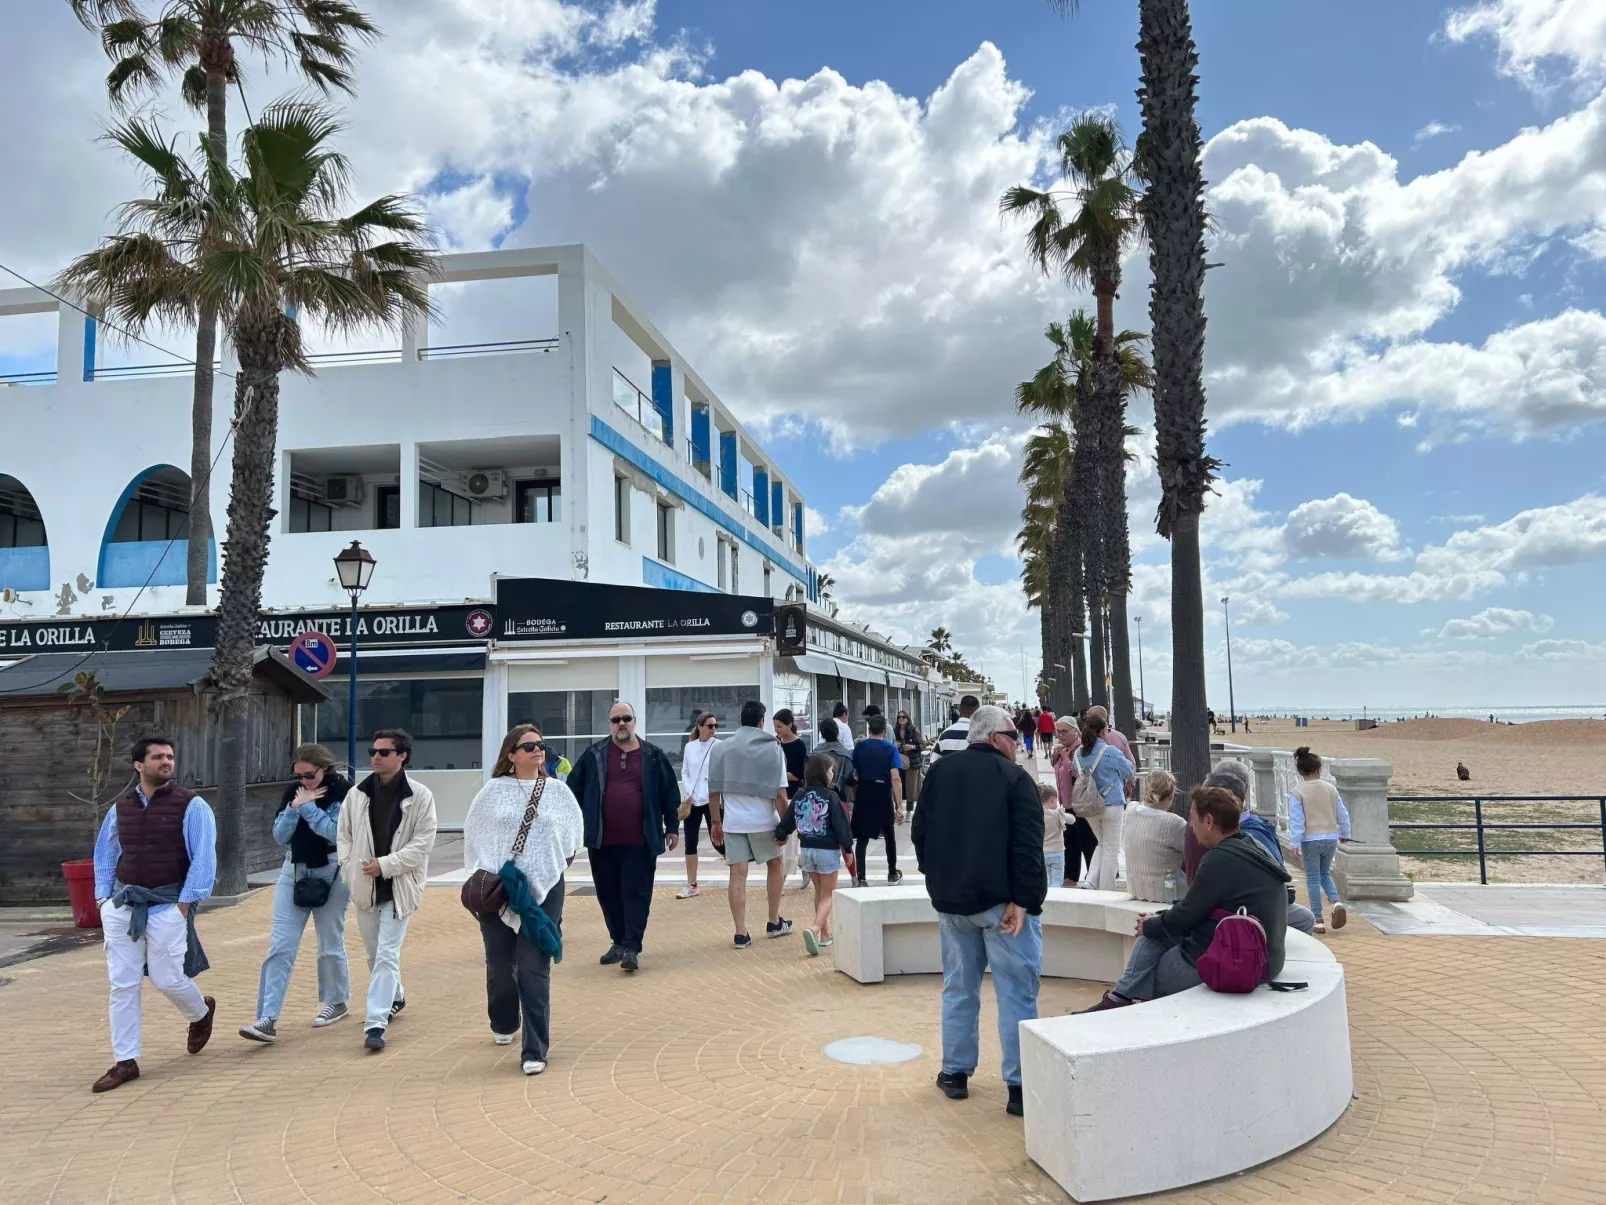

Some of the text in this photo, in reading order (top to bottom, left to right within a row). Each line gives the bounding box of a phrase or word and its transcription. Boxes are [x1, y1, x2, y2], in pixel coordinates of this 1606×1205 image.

[373, 615, 439, 635] ORILLA
[526, 618, 556, 626] BODEGA
[605, 618, 710, 630] RESTAURANTE LA ORILLA
[10, 629, 32, 647] LA
[36, 627, 96, 646] ORILLA
[159, 638, 191, 646] BODEGA
